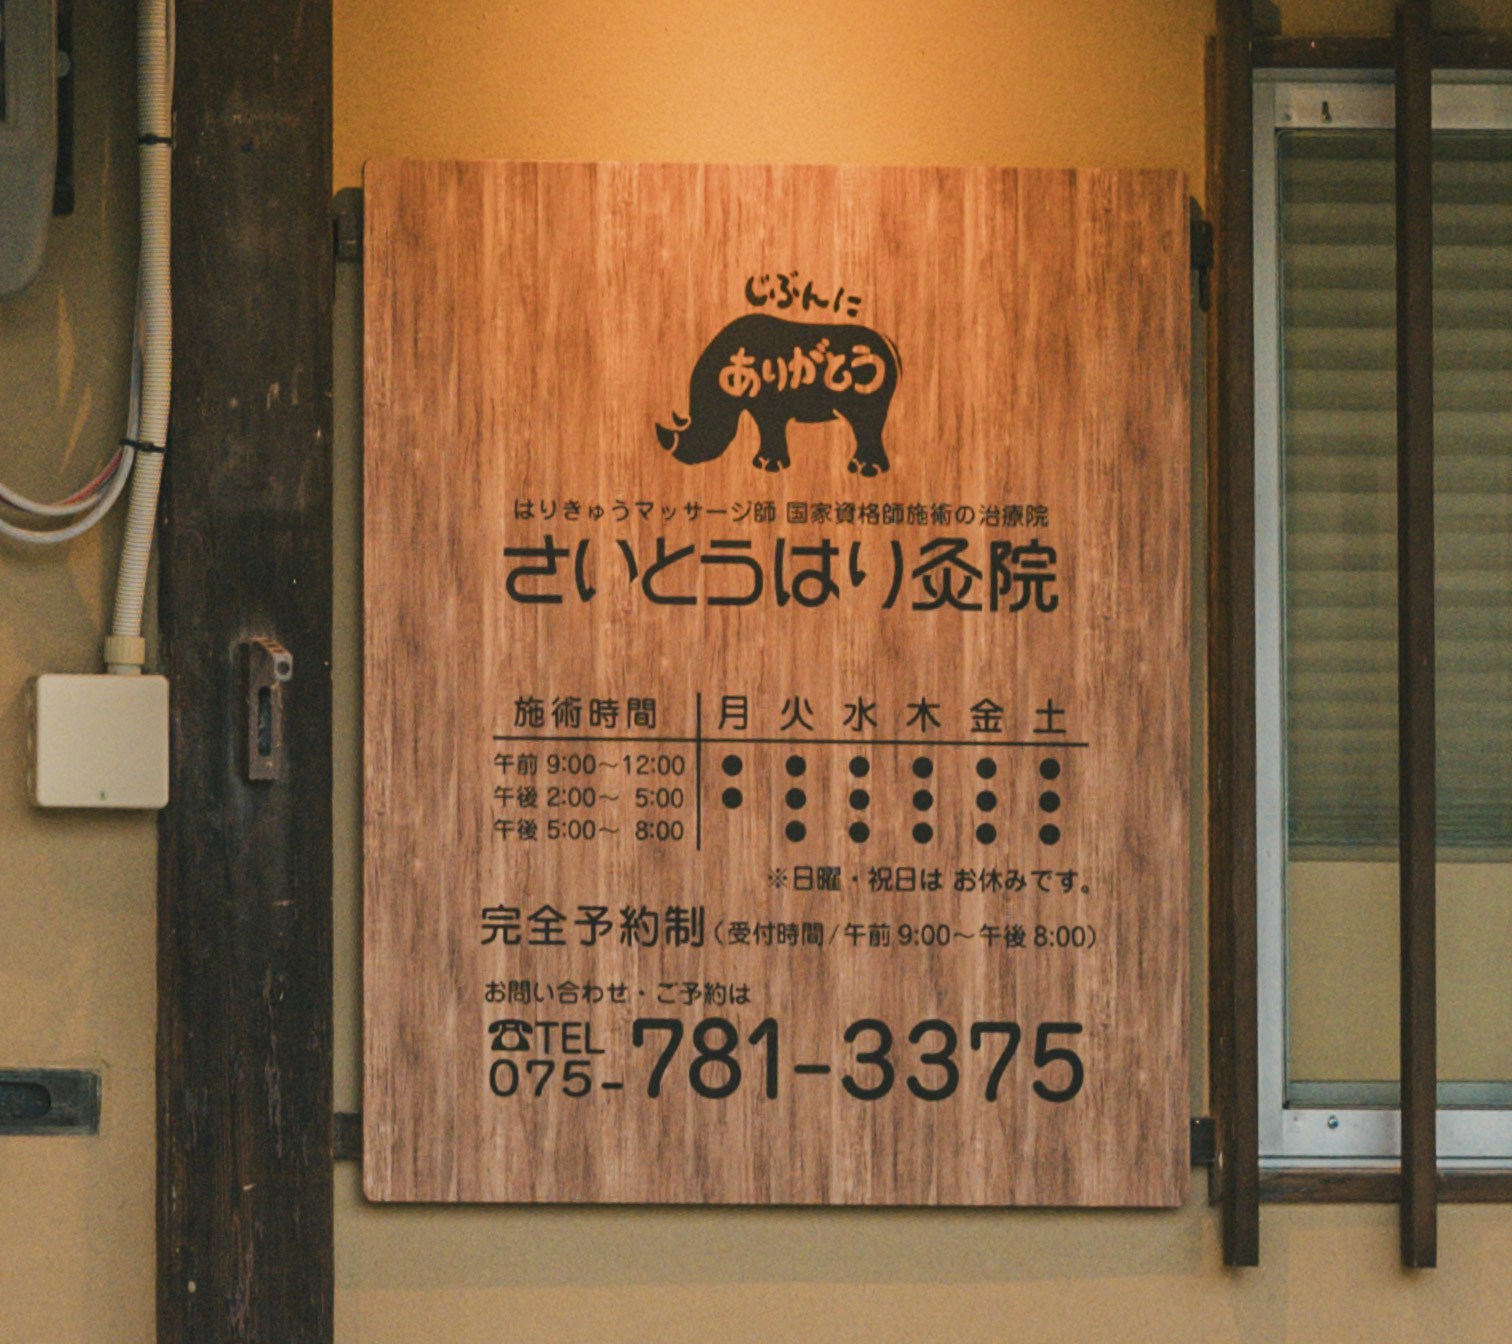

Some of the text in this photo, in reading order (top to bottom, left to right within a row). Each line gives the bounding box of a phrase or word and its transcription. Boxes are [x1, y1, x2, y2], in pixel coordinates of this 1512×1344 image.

[744, 270, 863, 318] じぶんに
[718, 338, 885, 399] ありがとう
[513, 498, 776, 523] はりきゅうマッサージ師
[503, 535, 1060, 613] さいとうはり灸院
[514, 694, 1068, 735] 施術時間 月 火 水 木 金 土
[480, 904, 705, 947] 完全予約制
[484, 979, 751, 1006] お問い合わせ・ご予約は
